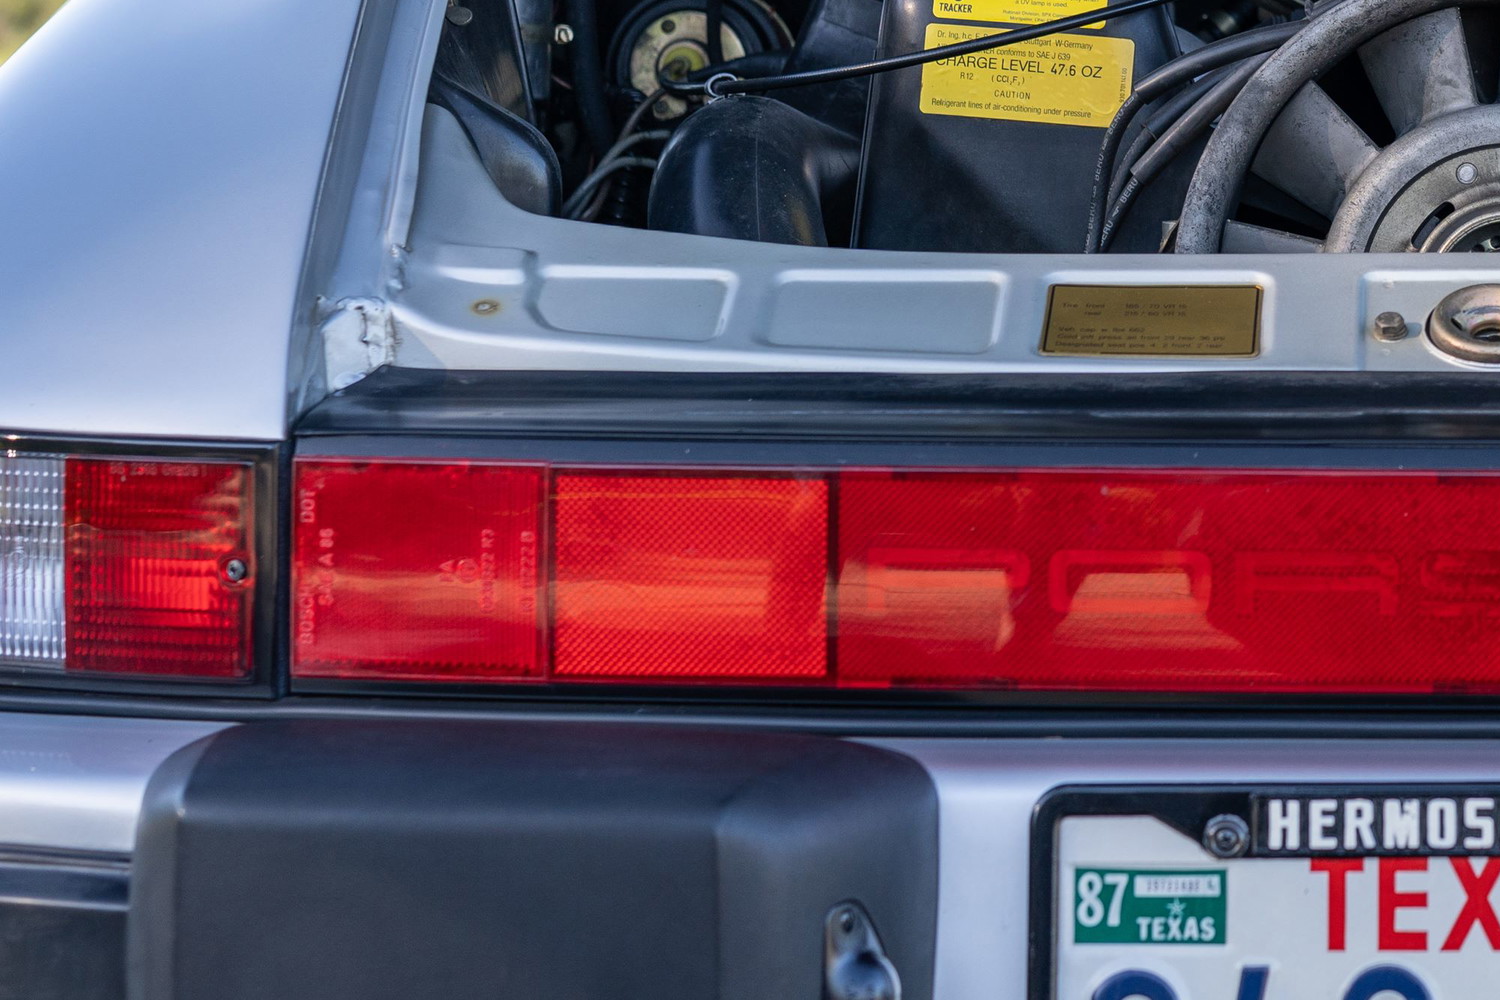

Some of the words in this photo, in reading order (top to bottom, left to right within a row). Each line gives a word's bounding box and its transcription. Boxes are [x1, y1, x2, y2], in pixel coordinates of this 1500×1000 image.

[939, 2, 973, 13] TRACKER
[937, 30, 946, 38] Dr.
[949, 31, 960, 39] Ing.
[1055, 39, 1094, 51] W-Germany
[996, 49, 1026, 57] conforms
[1028, 50, 1035, 58] to
[1036, 50, 1050, 59] SAE
[1051, 52, 1056, 60] J
[936, 55, 997, 70] CHARGE
[1001, 58, 1045, 73] LEVEL
[1081, 65, 1103, 78] OZ
[994, 90, 1031, 100] CAUTION
[931, 98, 967, 108] Refrigerant
[968, 101, 983, 109] lines
[992, 102, 1042, 116] air-conditioning
[1043, 105, 1062, 115] under
[1063, 108, 1091, 119] pressure
[1120, 178, 1139, 204] BERU
[299, 489, 316, 523] DOT
[298, 578, 315, 645] BOSCH
[1076, 871, 1130, 928] 87
[1136, 916, 1216, 941] TEXAS
